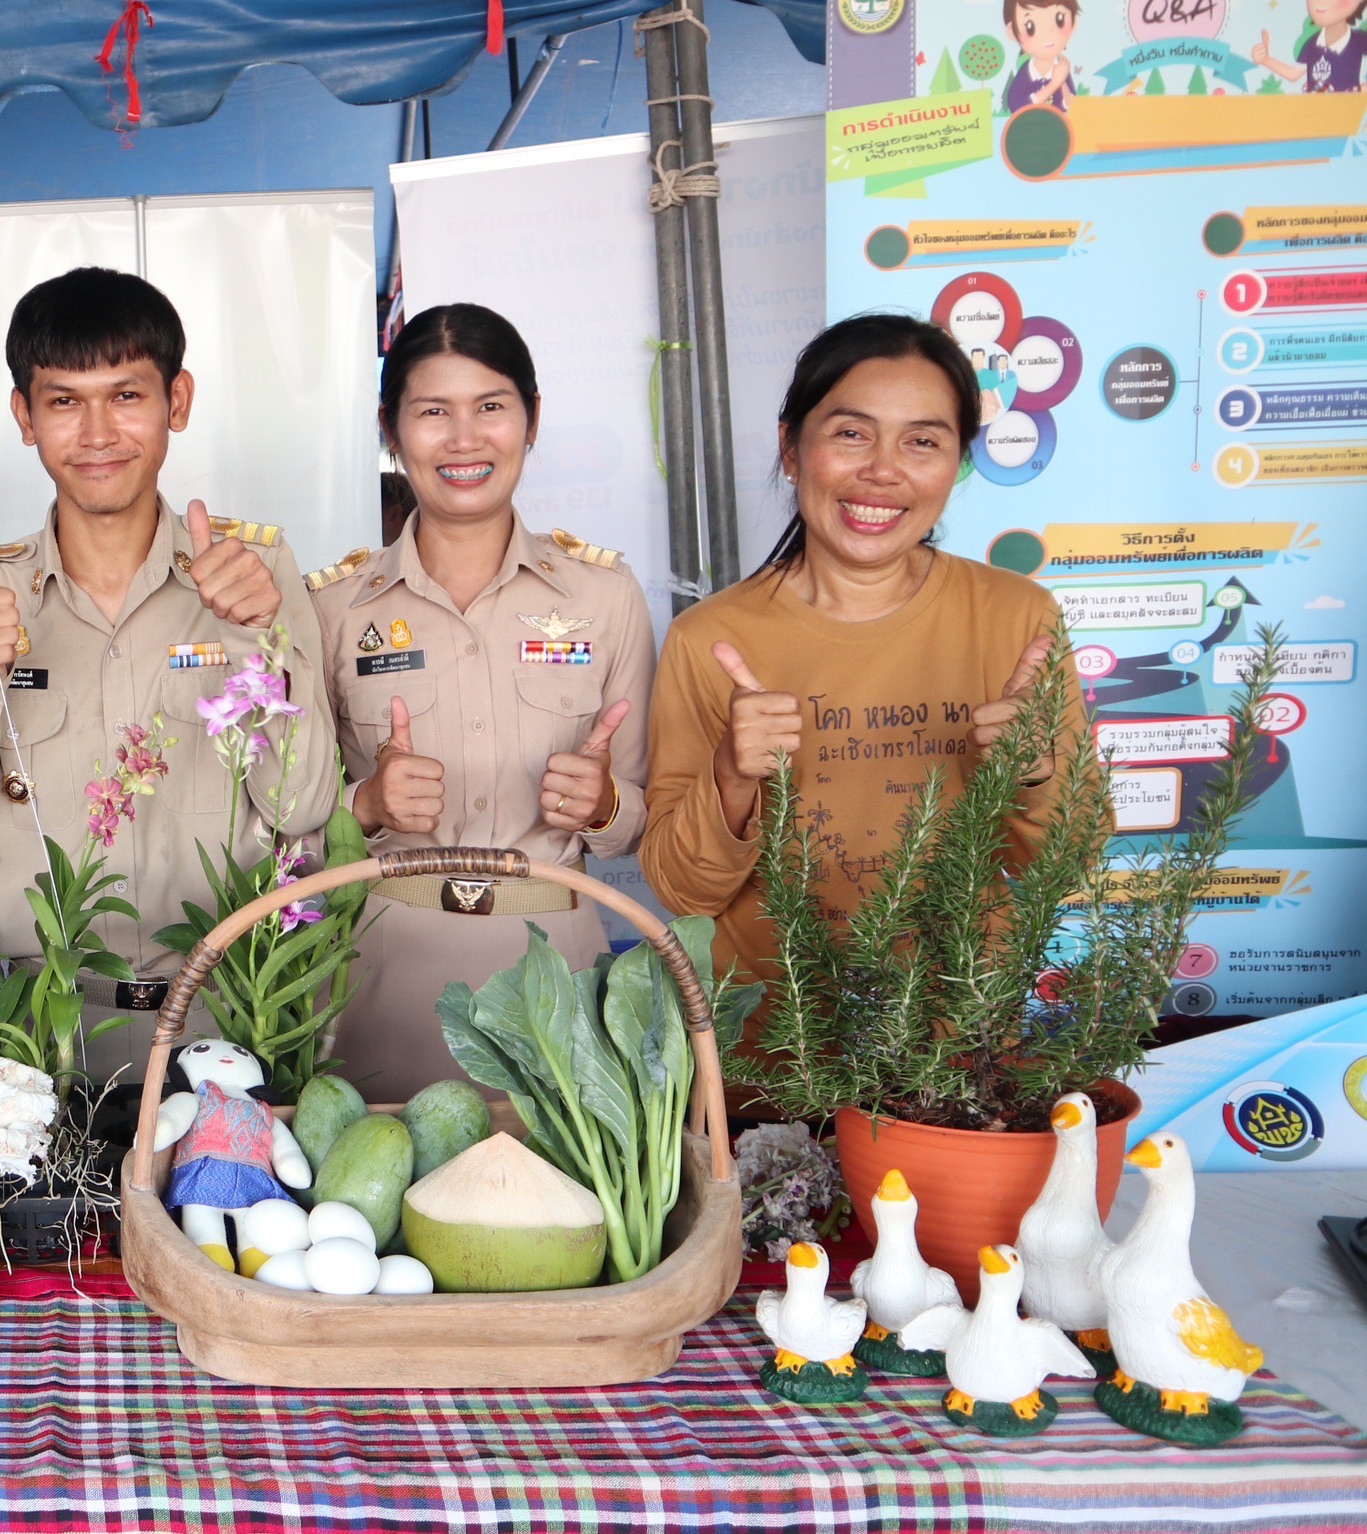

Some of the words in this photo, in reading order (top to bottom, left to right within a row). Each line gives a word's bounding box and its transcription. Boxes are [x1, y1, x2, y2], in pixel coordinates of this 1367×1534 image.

[1129, 48, 1165, 67] หนึ่งวัน
[1169, 42, 1224, 63] หนึ่งคำถาม
[842, 103, 971, 136] การดำเนินงาน
[847, 117, 980, 154] กลุ่มออมทรัพย์
[865, 137, 966, 162] เพื่อการผลิต
[967, 277, 977, 286] 01
[1236, 283, 1247, 303] 1
[1062, 337, 1074, 347] 02
[1232, 342, 1248, 361] 2
[1120, 361, 1162, 372] หลักการ
[1111, 376, 1170, 391] กลุ่มออมทรัพย์
[1115, 393, 1165, 404] เพื่อการผลิต
[1266, 393, 1324, 406] หลักคุณธรรม
[1229, 400, 1244, 418] 3
[1031, 461, 1043, 470] 03
[1228, 457, 1243, 474] 4
[1121, 528, 1195, 546] วิธีการตั้ง
[1050, 546, 1263, 570] กลุ่มออมทรัพย์เพื่อการผลิต
[1064, 593, 1140, 605] จัดทำเอกสาร
[1146, 591, 1189, 603] ทะเบียน
[1220, 591, 1238, 602] 05
[1177, 648, 1195, 659] 04
[1313, 648, 1347, 661] กติกา
[1079, 655, 1104, 669] 03
[808, 693, 851, 731] โคก
[864, 702, 929, 730] หนอง
[942, 701, 970, 724] นา
[1258, 707, 1290, 723] 02
[819, 728, 967, 762] ฉะเชิงเทราโมเดล
[1189, 954, 1203, 967] 7
[1229, 948, 1362, 961] ขอรับการสนับสนุนจาก
[1229, 959, 1332, 972] หน่วยงานราชการ
[1187, 993, 1200, 1006] 8
